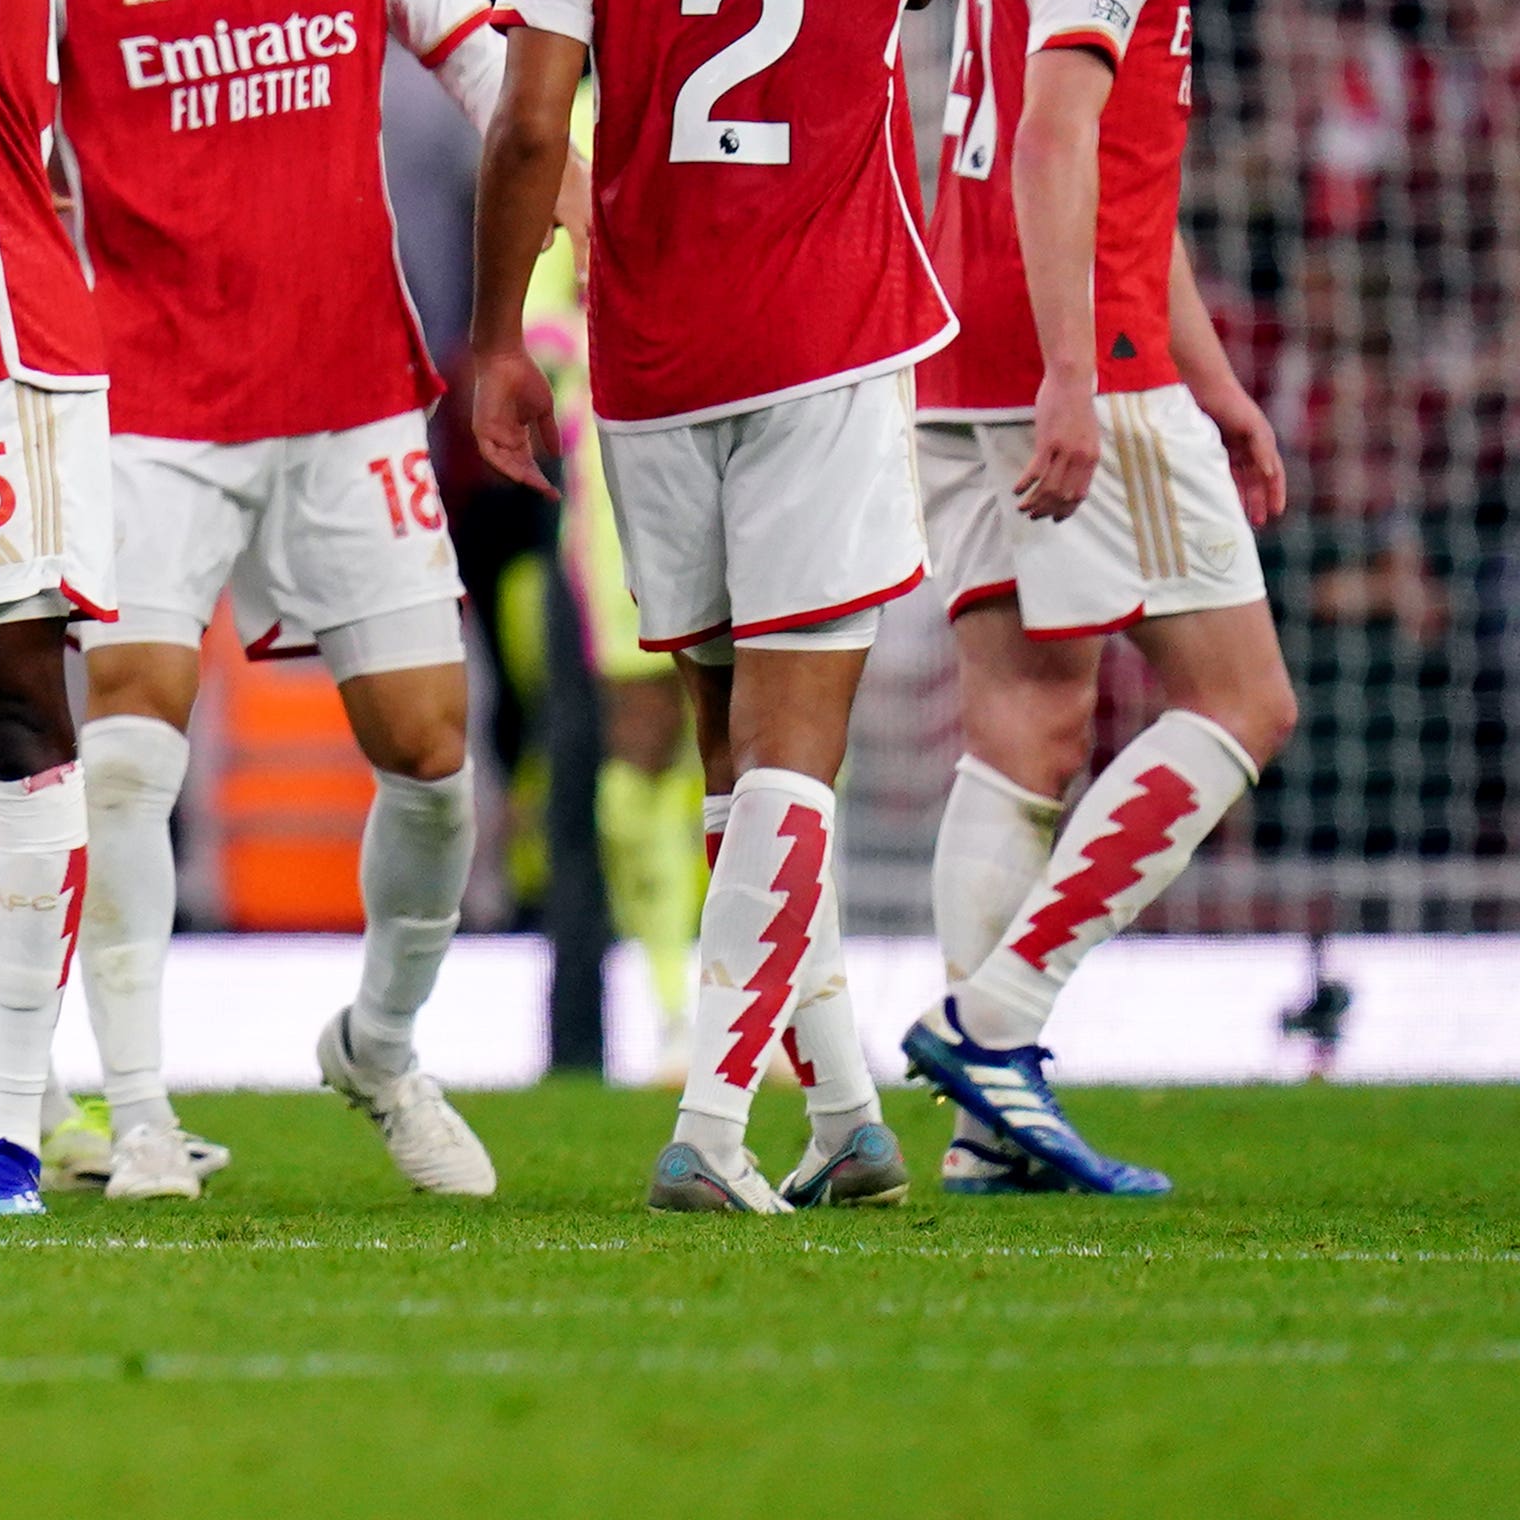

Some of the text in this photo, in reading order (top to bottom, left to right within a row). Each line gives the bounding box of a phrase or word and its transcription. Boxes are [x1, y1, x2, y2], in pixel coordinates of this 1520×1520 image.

[119, 10, 358, 91] Emirates
[170, 63, 332, 133] FLY BETTER
[368, 450, 443, 540] 18
